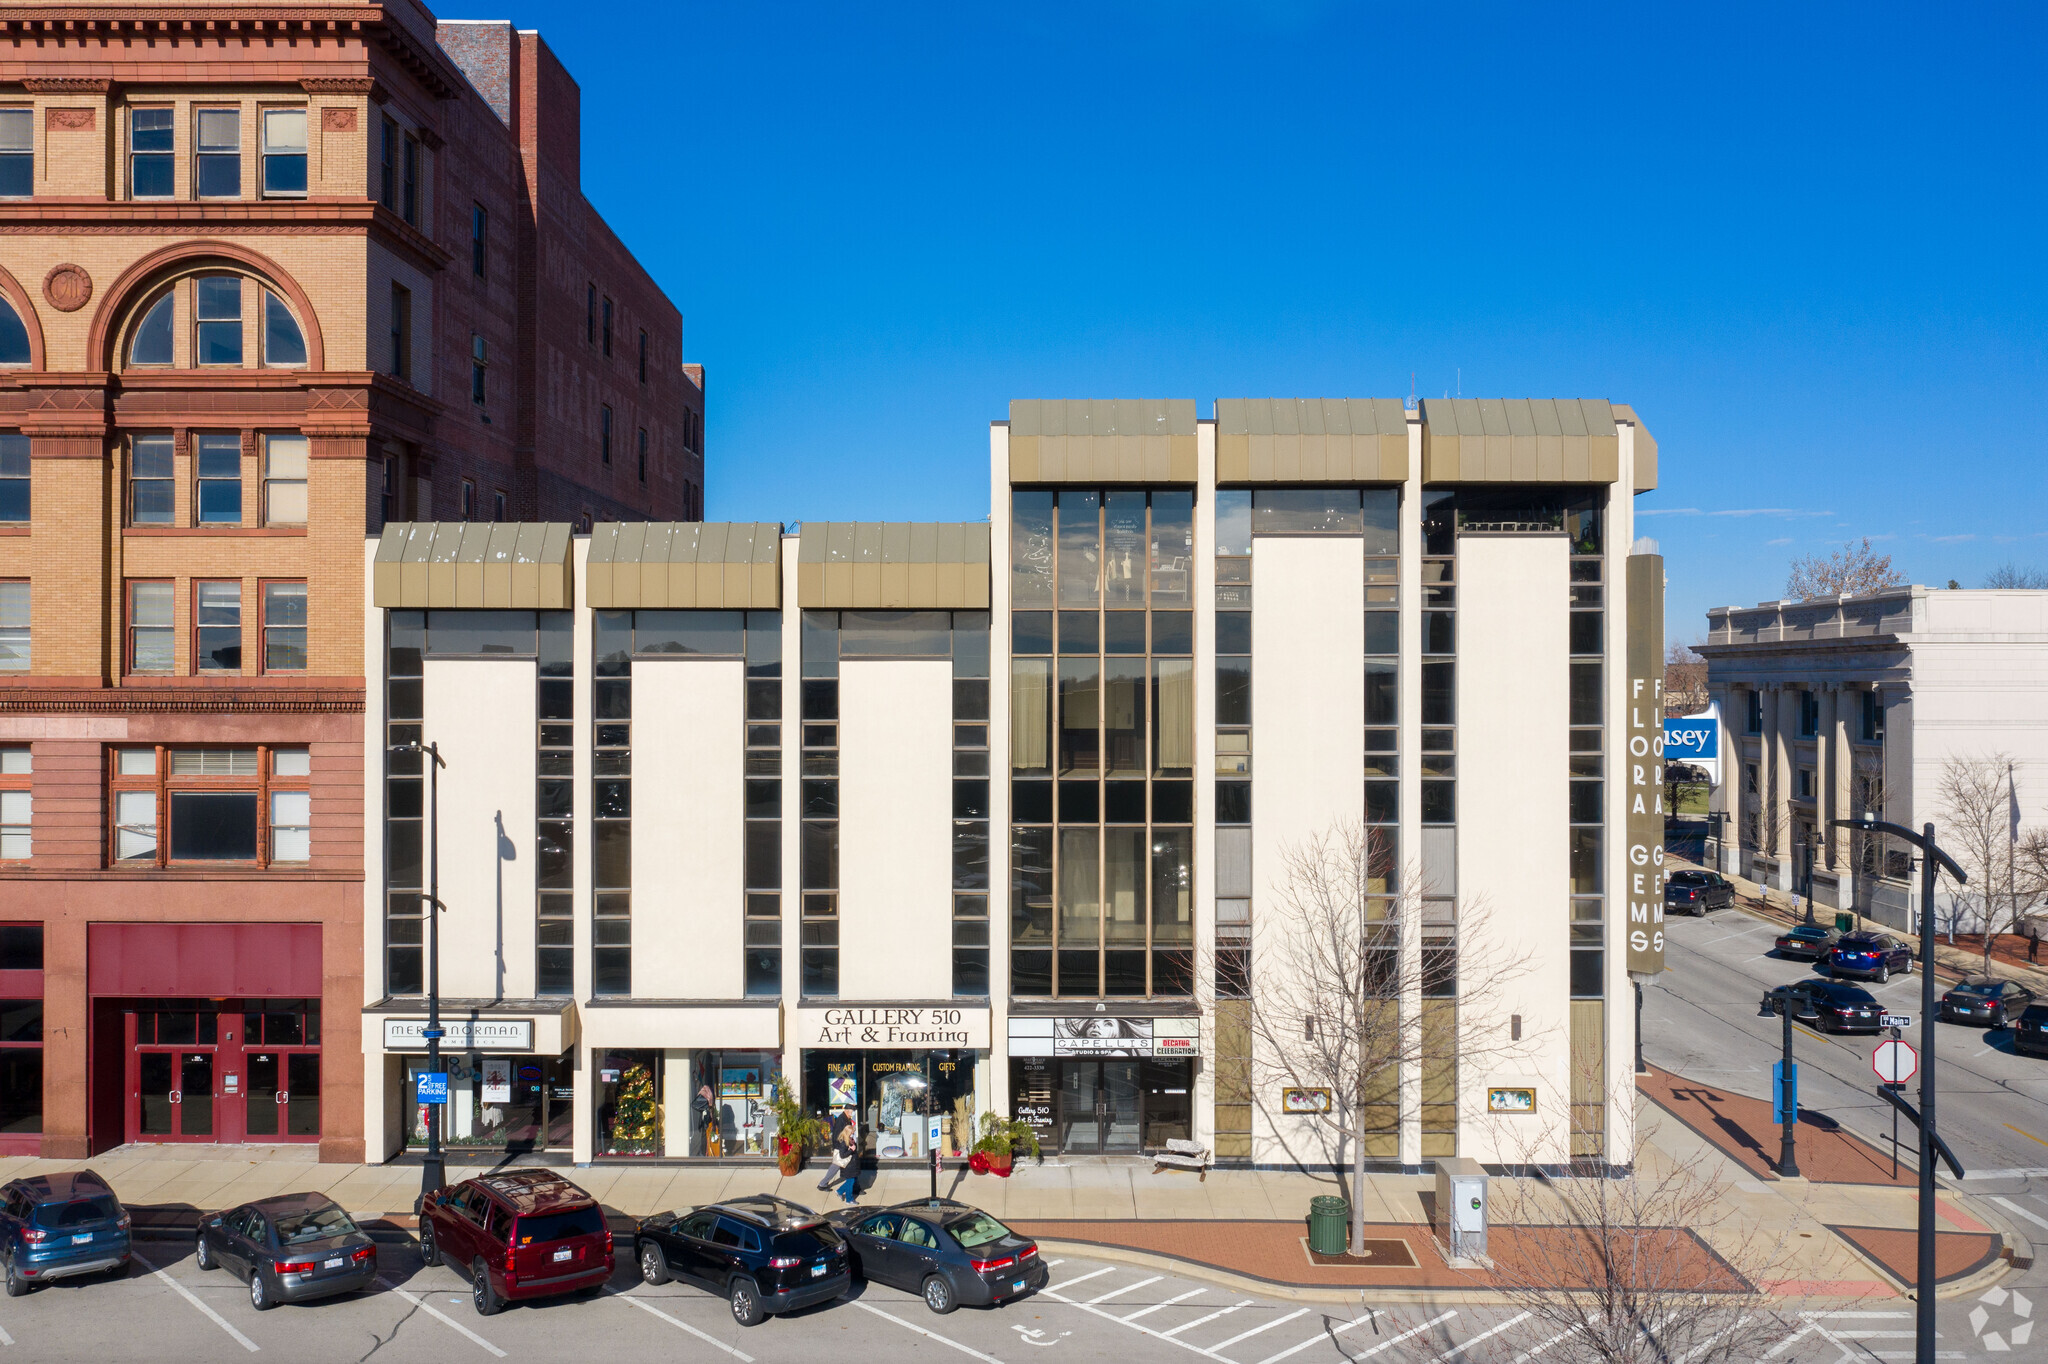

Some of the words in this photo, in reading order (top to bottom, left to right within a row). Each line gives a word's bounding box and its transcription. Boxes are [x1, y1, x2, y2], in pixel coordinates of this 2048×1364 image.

[1630, 679, 1649, 814] FLORA
[1653, 679, 1663, 814] FLORA
[1630, 844, 1649, 952] GEMS
[1653, 845, 1664, 953] GEMS
[825, 1009, 923, 1024] GALLERY
[931, 1009, 961, 1025] 510
[1890, 1016, 1904, 1025] Main
[392, 1025, 446, 1035] MER
[451, 1025, 518, 1035] NORMAN
[817, 1027, 852, 1045] Art
[861, 1027, 880, 1042] &
[887, 1027, 969, 1047] Framing
[1058, 1039, 1149, 1048] CAPELLIS
[1162, 1039, 1190, 1047] DECATUR
[1156, 1047, 1196, 1055] CELEBRATION
[827, 1063, 841, 1072] FINE
[842, 1063, 855, 1072] ART
[872, 1063, 895, 1072] CUSTOM
[895, 1063, 920, 1072] FRAMING
[938, 1063, 955, 1071] GIFTS
[418, 1074, 428, 1089] 2
[1018, 1106, 1036, 1116] Gallery
[1037, 1106, 1050, 1114] 510
